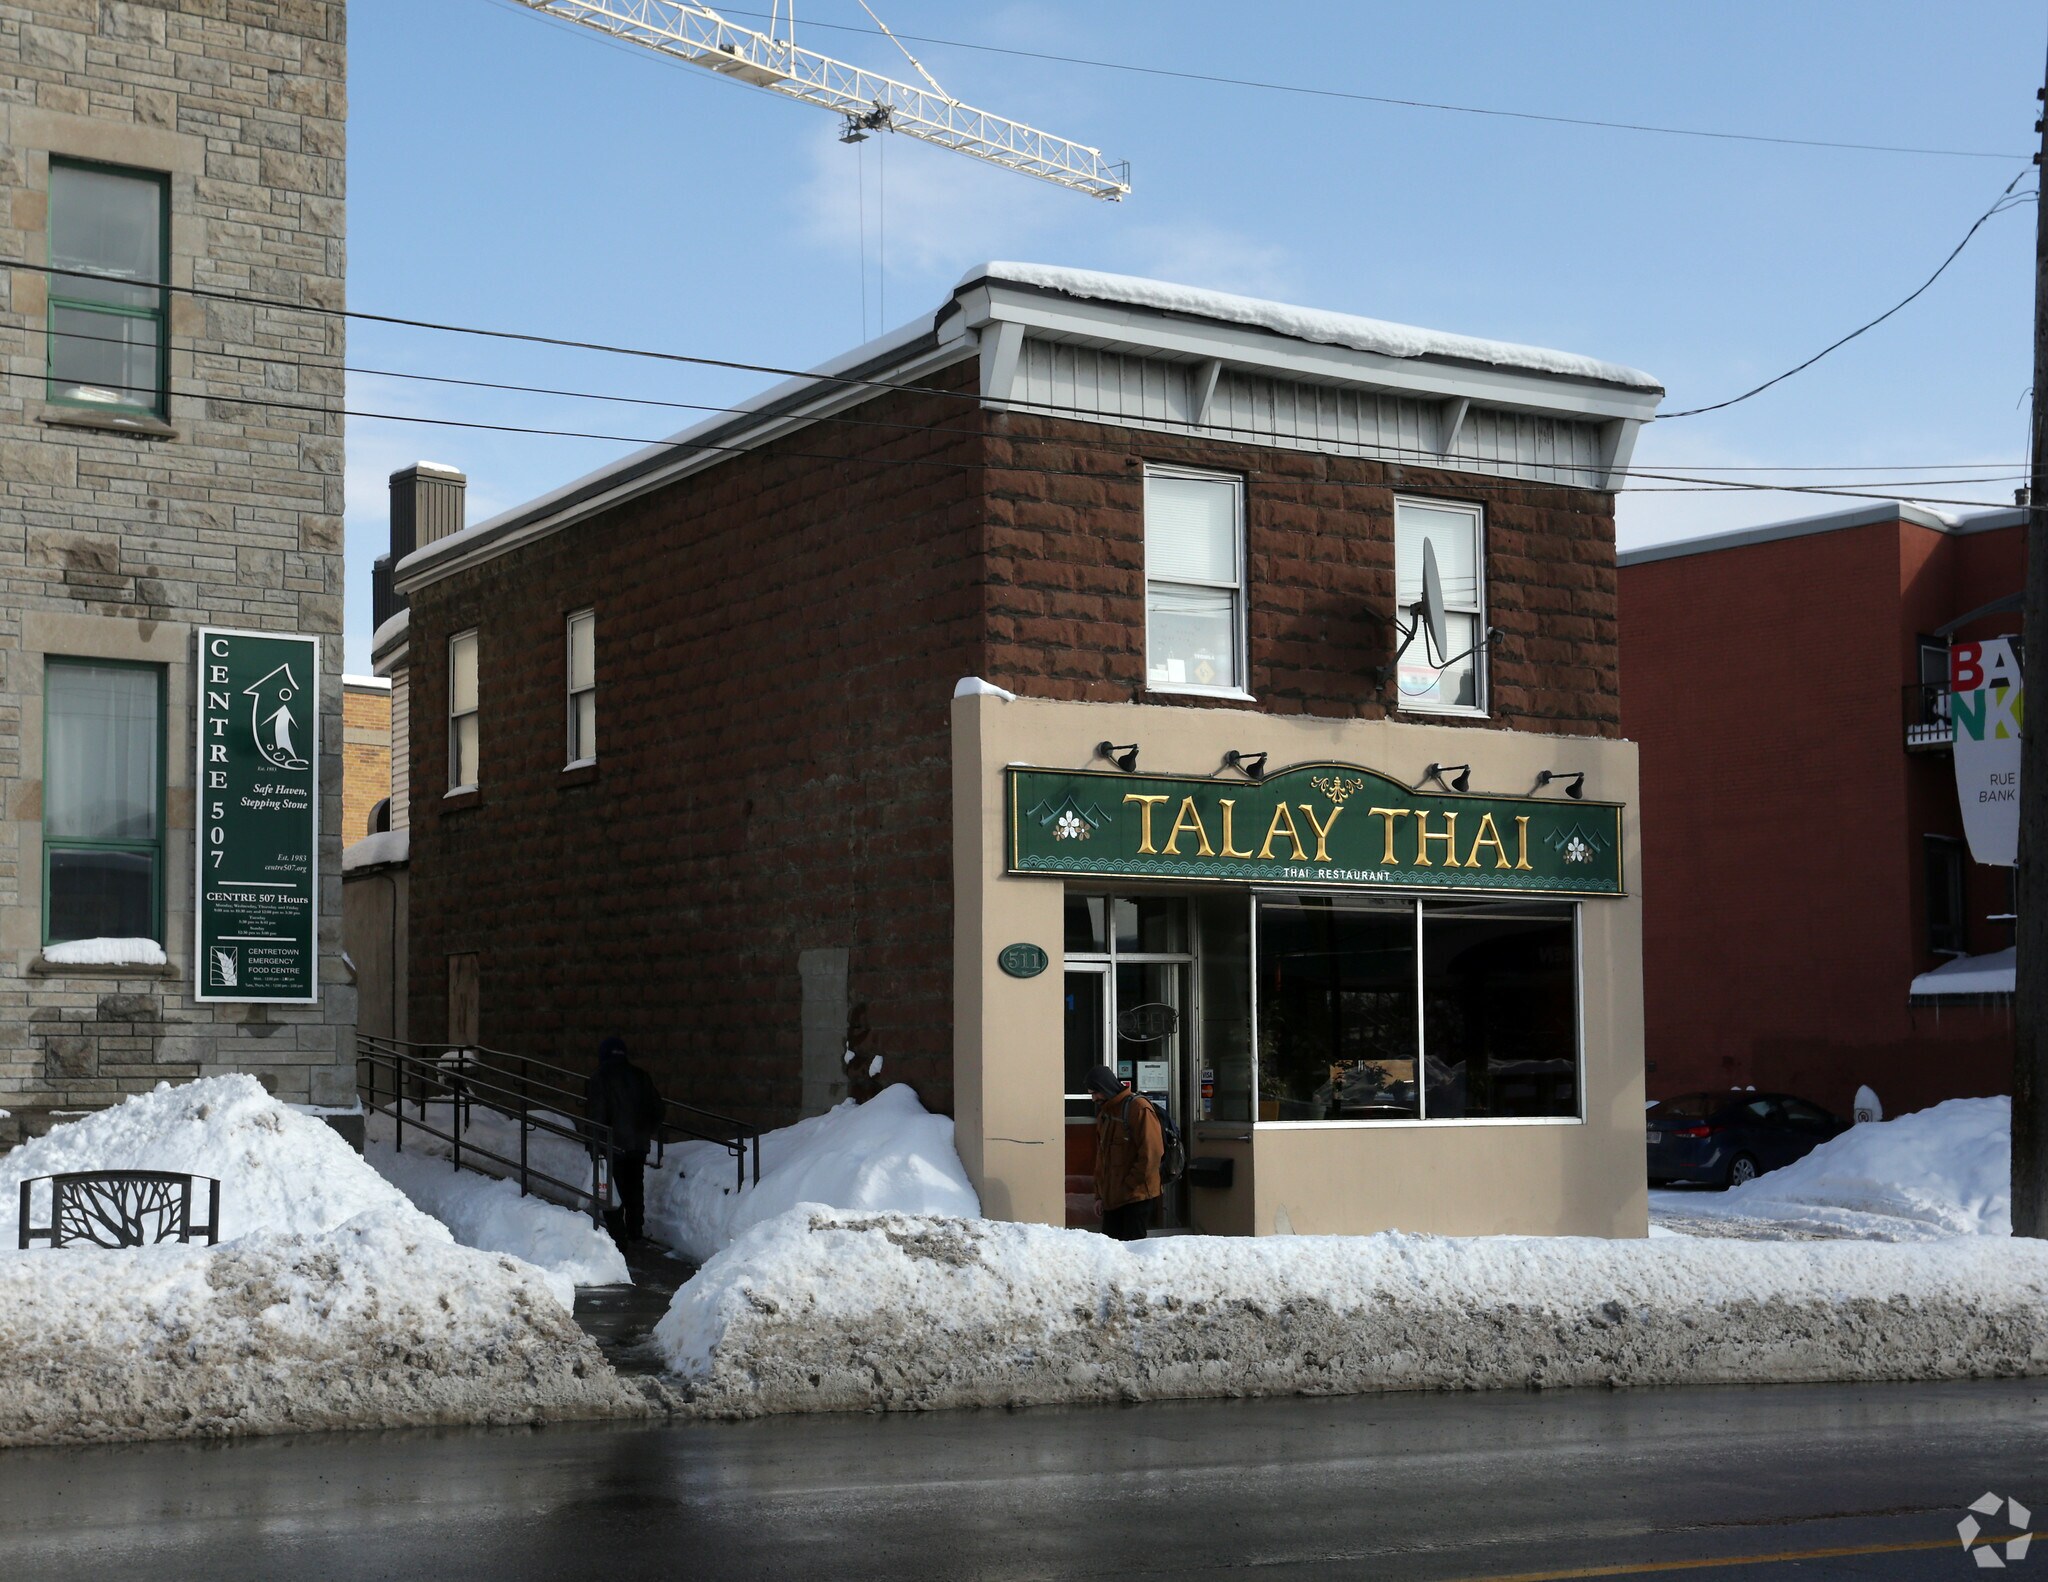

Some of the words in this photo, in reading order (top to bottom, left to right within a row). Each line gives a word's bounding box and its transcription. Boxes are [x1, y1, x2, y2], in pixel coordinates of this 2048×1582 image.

[207, 638, 231, 790] CENTRE
[1990, 773, 2015, 785] RUE
[253, 783, 273, 796] Safe
[275, 784, 307, 796] Haven,
[1979, 789, 2015, 803] BANK
[240, 796, 281, 811] Stepping
[282, 798, 308, 809] Stone
[210, 802, 224, 869] 507
[1122, 793, 1345, 863] TALAY
[1367, 806, 1534, 871] THAI
[277, 853, 289, 861] Est.
[291, 854, 307, 862] 1983
[264, 864, 307, 873] centre507.org
[1284, 868, 1309, 878] THAI
[1318, 869, 1390, 880] RESTAURANT
[206, 892, 257, 902] CENTRE
[259, 894, 275, 903] 507
[278, 895, 309, 904] Hours
[1008, 951, 1040, 969] 511
